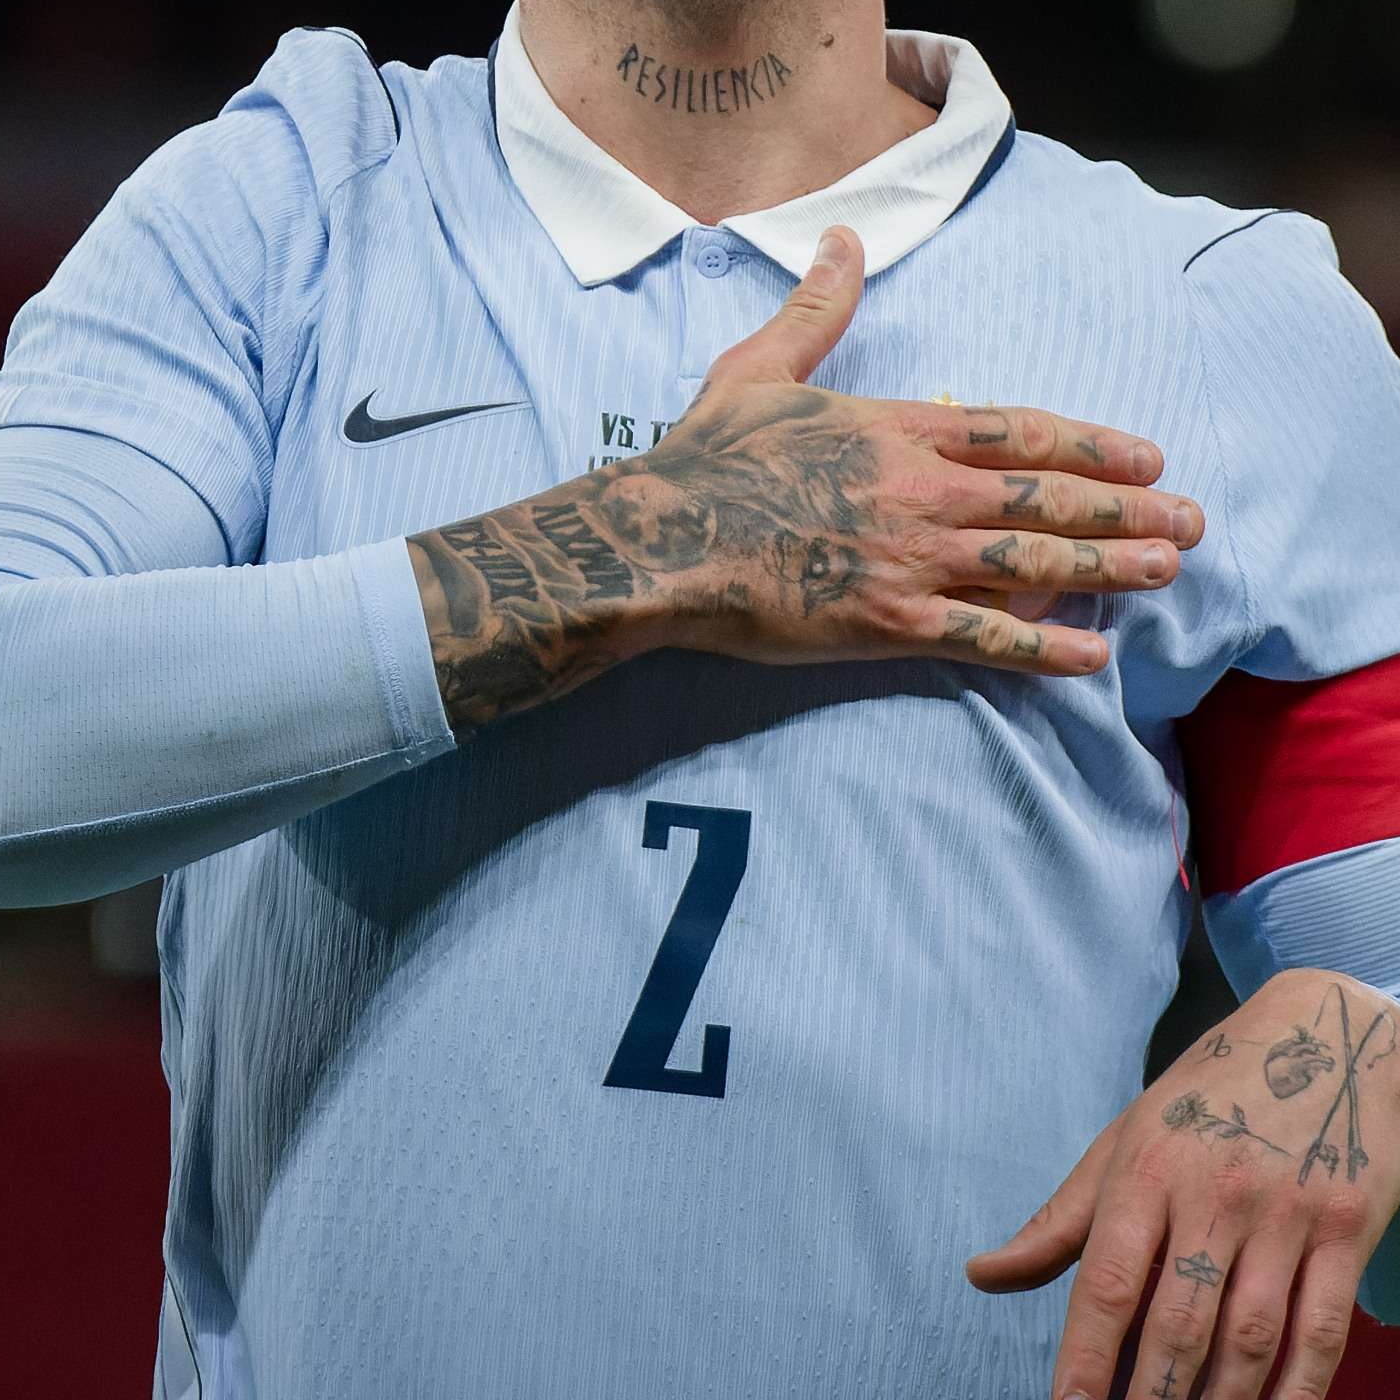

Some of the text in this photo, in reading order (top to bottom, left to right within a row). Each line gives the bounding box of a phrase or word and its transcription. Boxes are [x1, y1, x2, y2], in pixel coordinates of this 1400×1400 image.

[617, 43, 793, 113] RESILIENCIA
[601, 412, 639, 450] VS.
[602, 800, 752, 1099] 2
